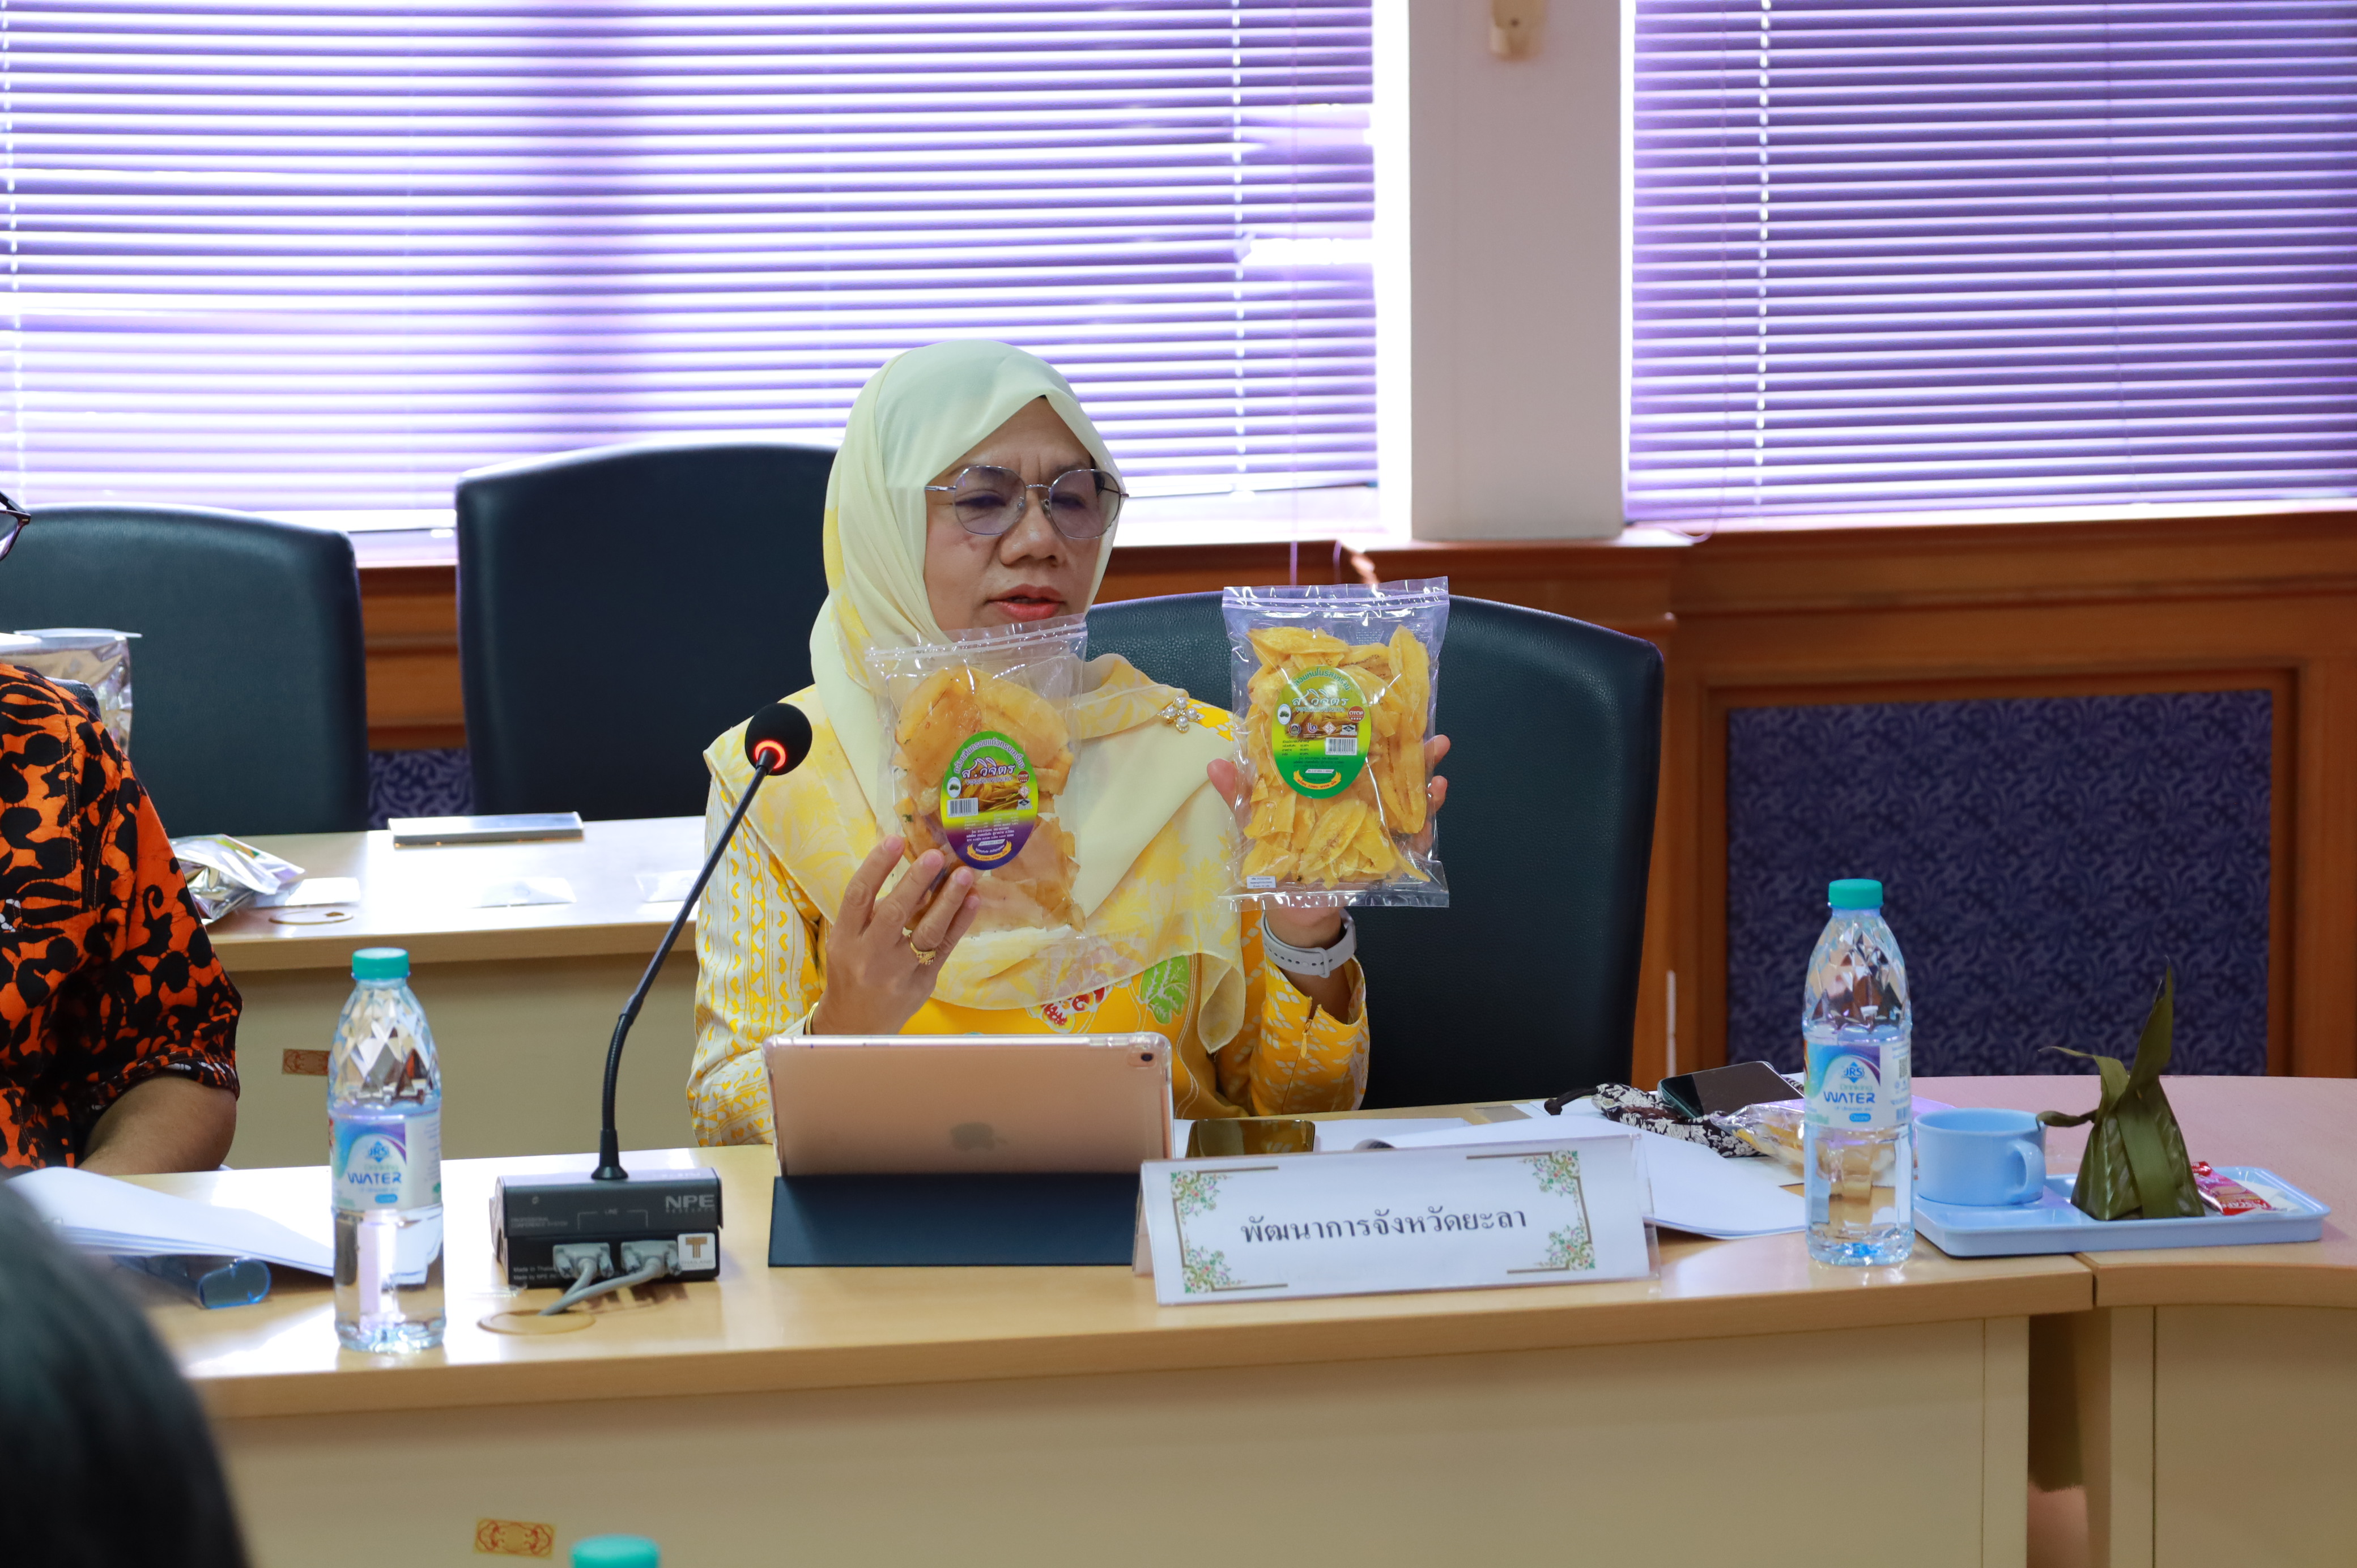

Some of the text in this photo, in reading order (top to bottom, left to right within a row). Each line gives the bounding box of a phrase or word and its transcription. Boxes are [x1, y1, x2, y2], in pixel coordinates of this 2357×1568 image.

[1294, 667, 1351, 691] ล้วยหินโนริสาหร่าย
[961, 756, 1016, 778] ส.วิจิตร
[1844, 1067, 1863, 1076] JRS
[1823, 1091, 1875, 1104] WATER
[347, 1173, 402, 1184] WATER
[666, 1194, 715, 1208] NPE
[1241, 1205, 1528, 1243] พัฒนาการจังหวัดยะลา
